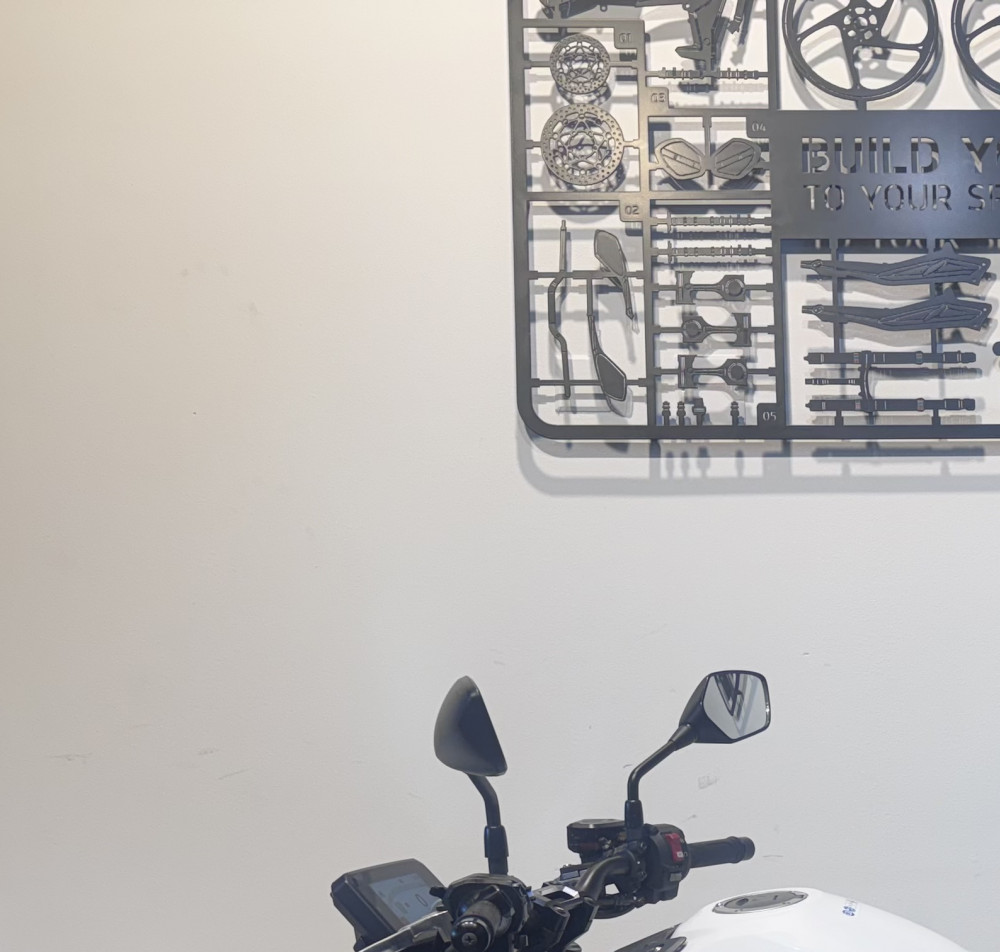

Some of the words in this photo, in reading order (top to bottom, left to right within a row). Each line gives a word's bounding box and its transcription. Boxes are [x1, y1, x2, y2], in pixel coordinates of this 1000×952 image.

[752, 121, 766, 131] 04
[801, 136, 940, 174] BUILD
[803, 183, 846, 212] TO
[860, 183, 952, 212] YOUR
[625, 205, 640, 215] 02
[762, 411, 777, 421] 05
